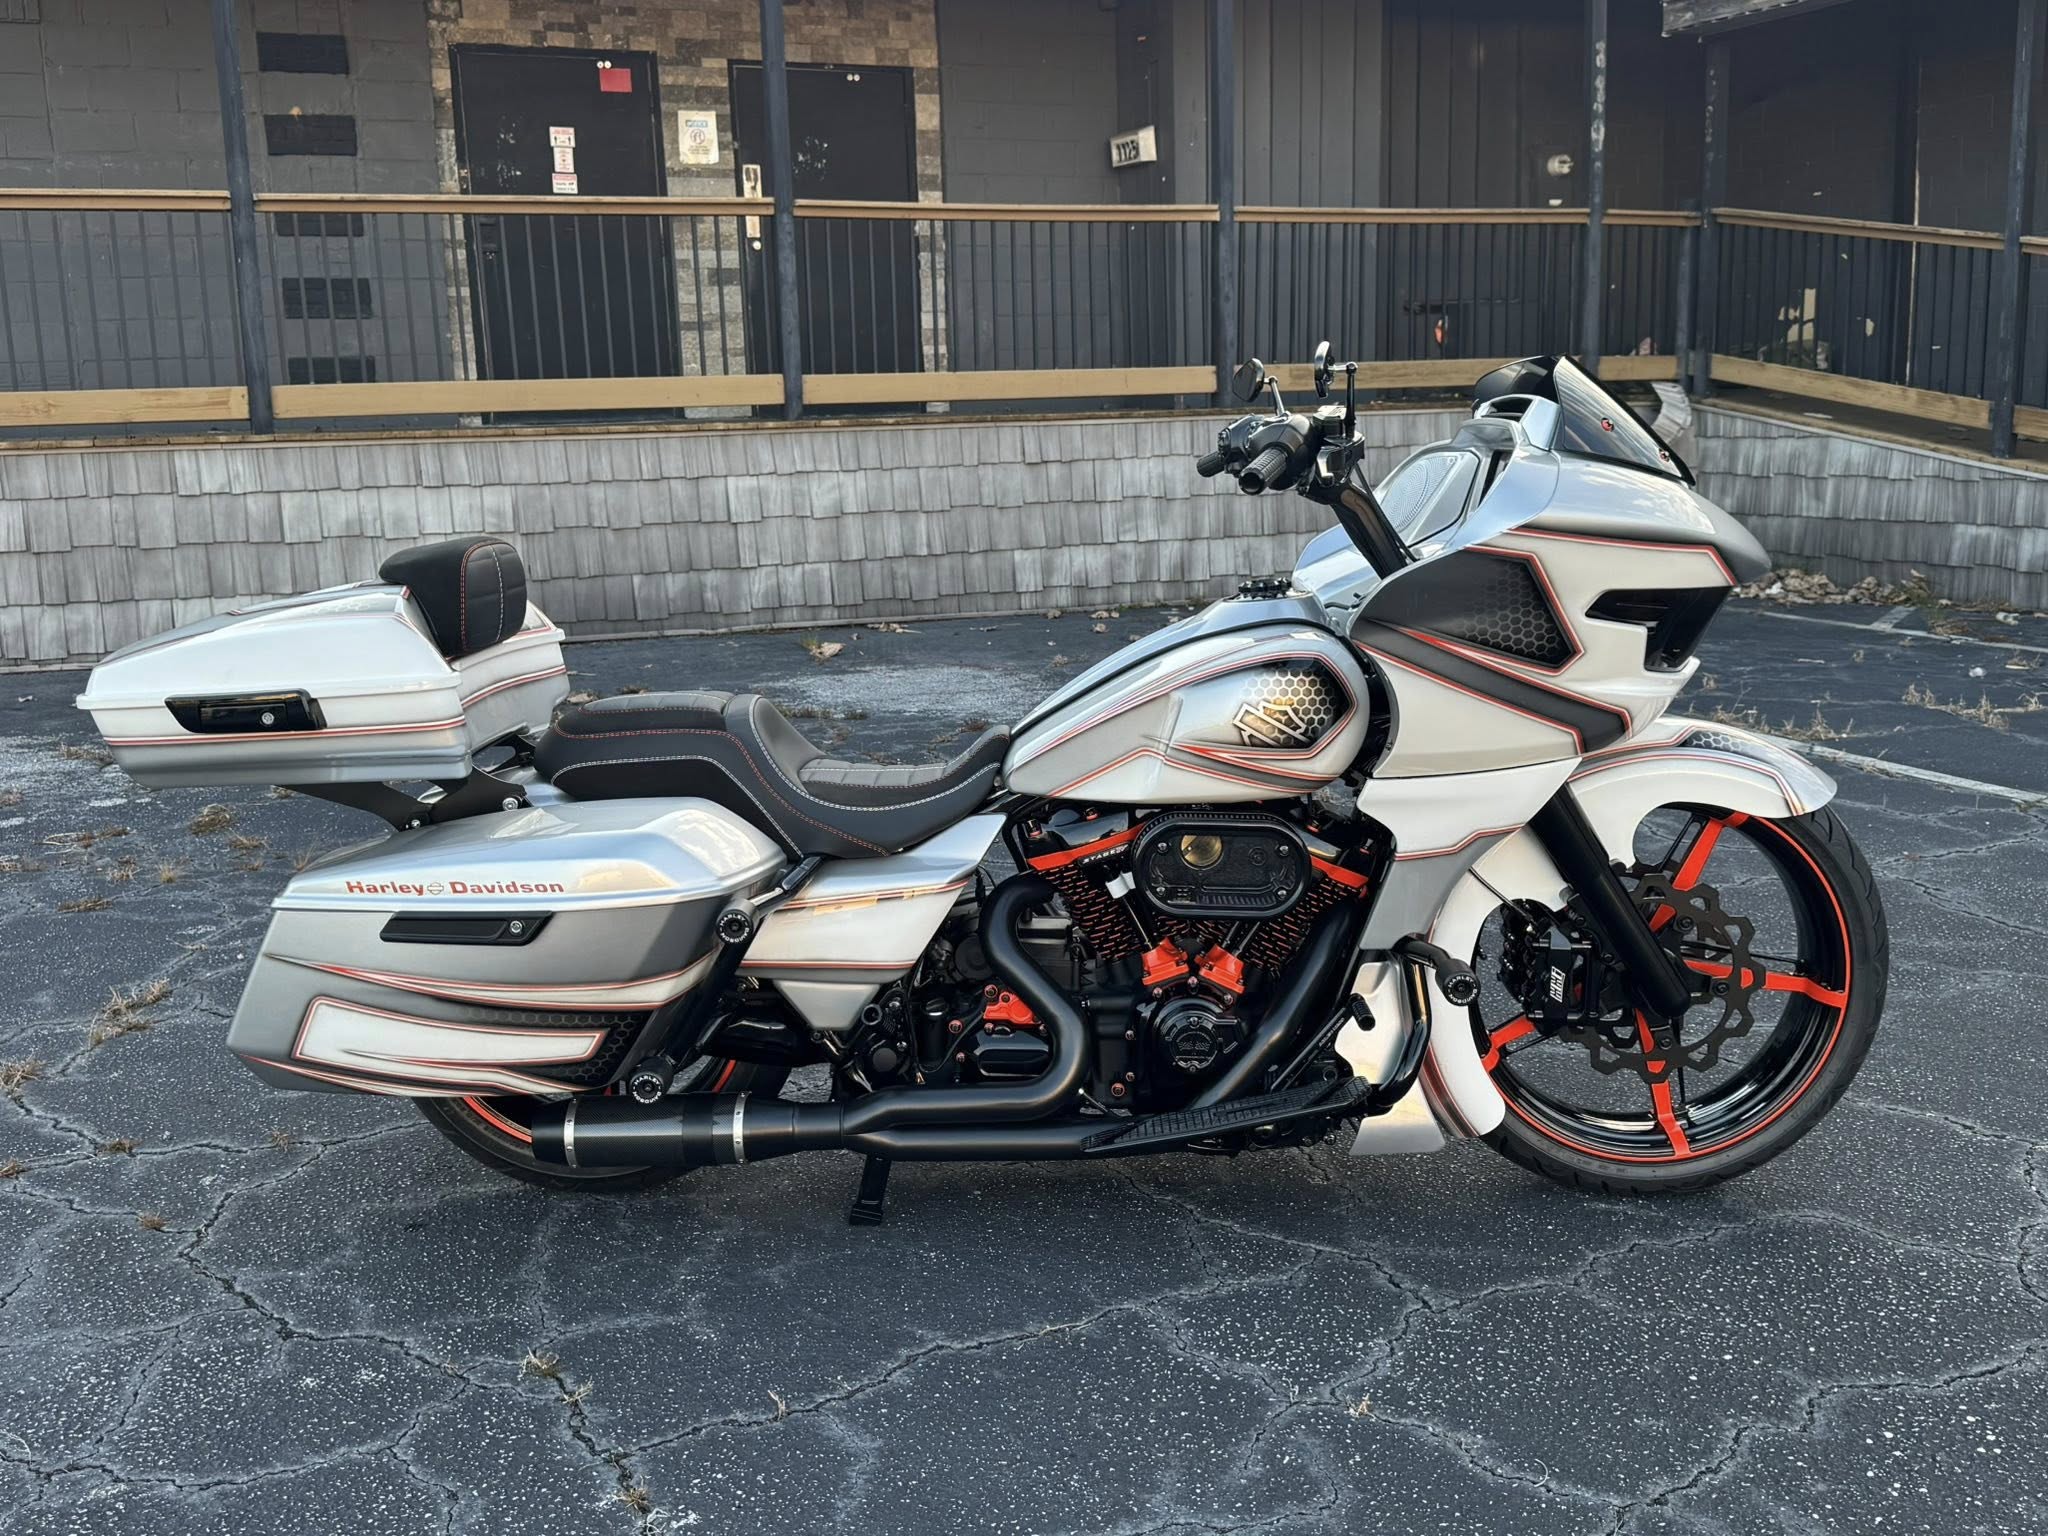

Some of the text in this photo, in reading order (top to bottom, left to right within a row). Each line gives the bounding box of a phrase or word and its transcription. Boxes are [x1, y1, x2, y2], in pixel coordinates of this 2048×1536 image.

[345, 881, 565, 896] Harley Davidson
[720, 913, 750, 943] HARLEY DAVIDSON
[1448, 975, 1478, 1004] HARLEY DAVIDSON
[632, 1075, 662, 1104] HARLEY DAVIDSON
